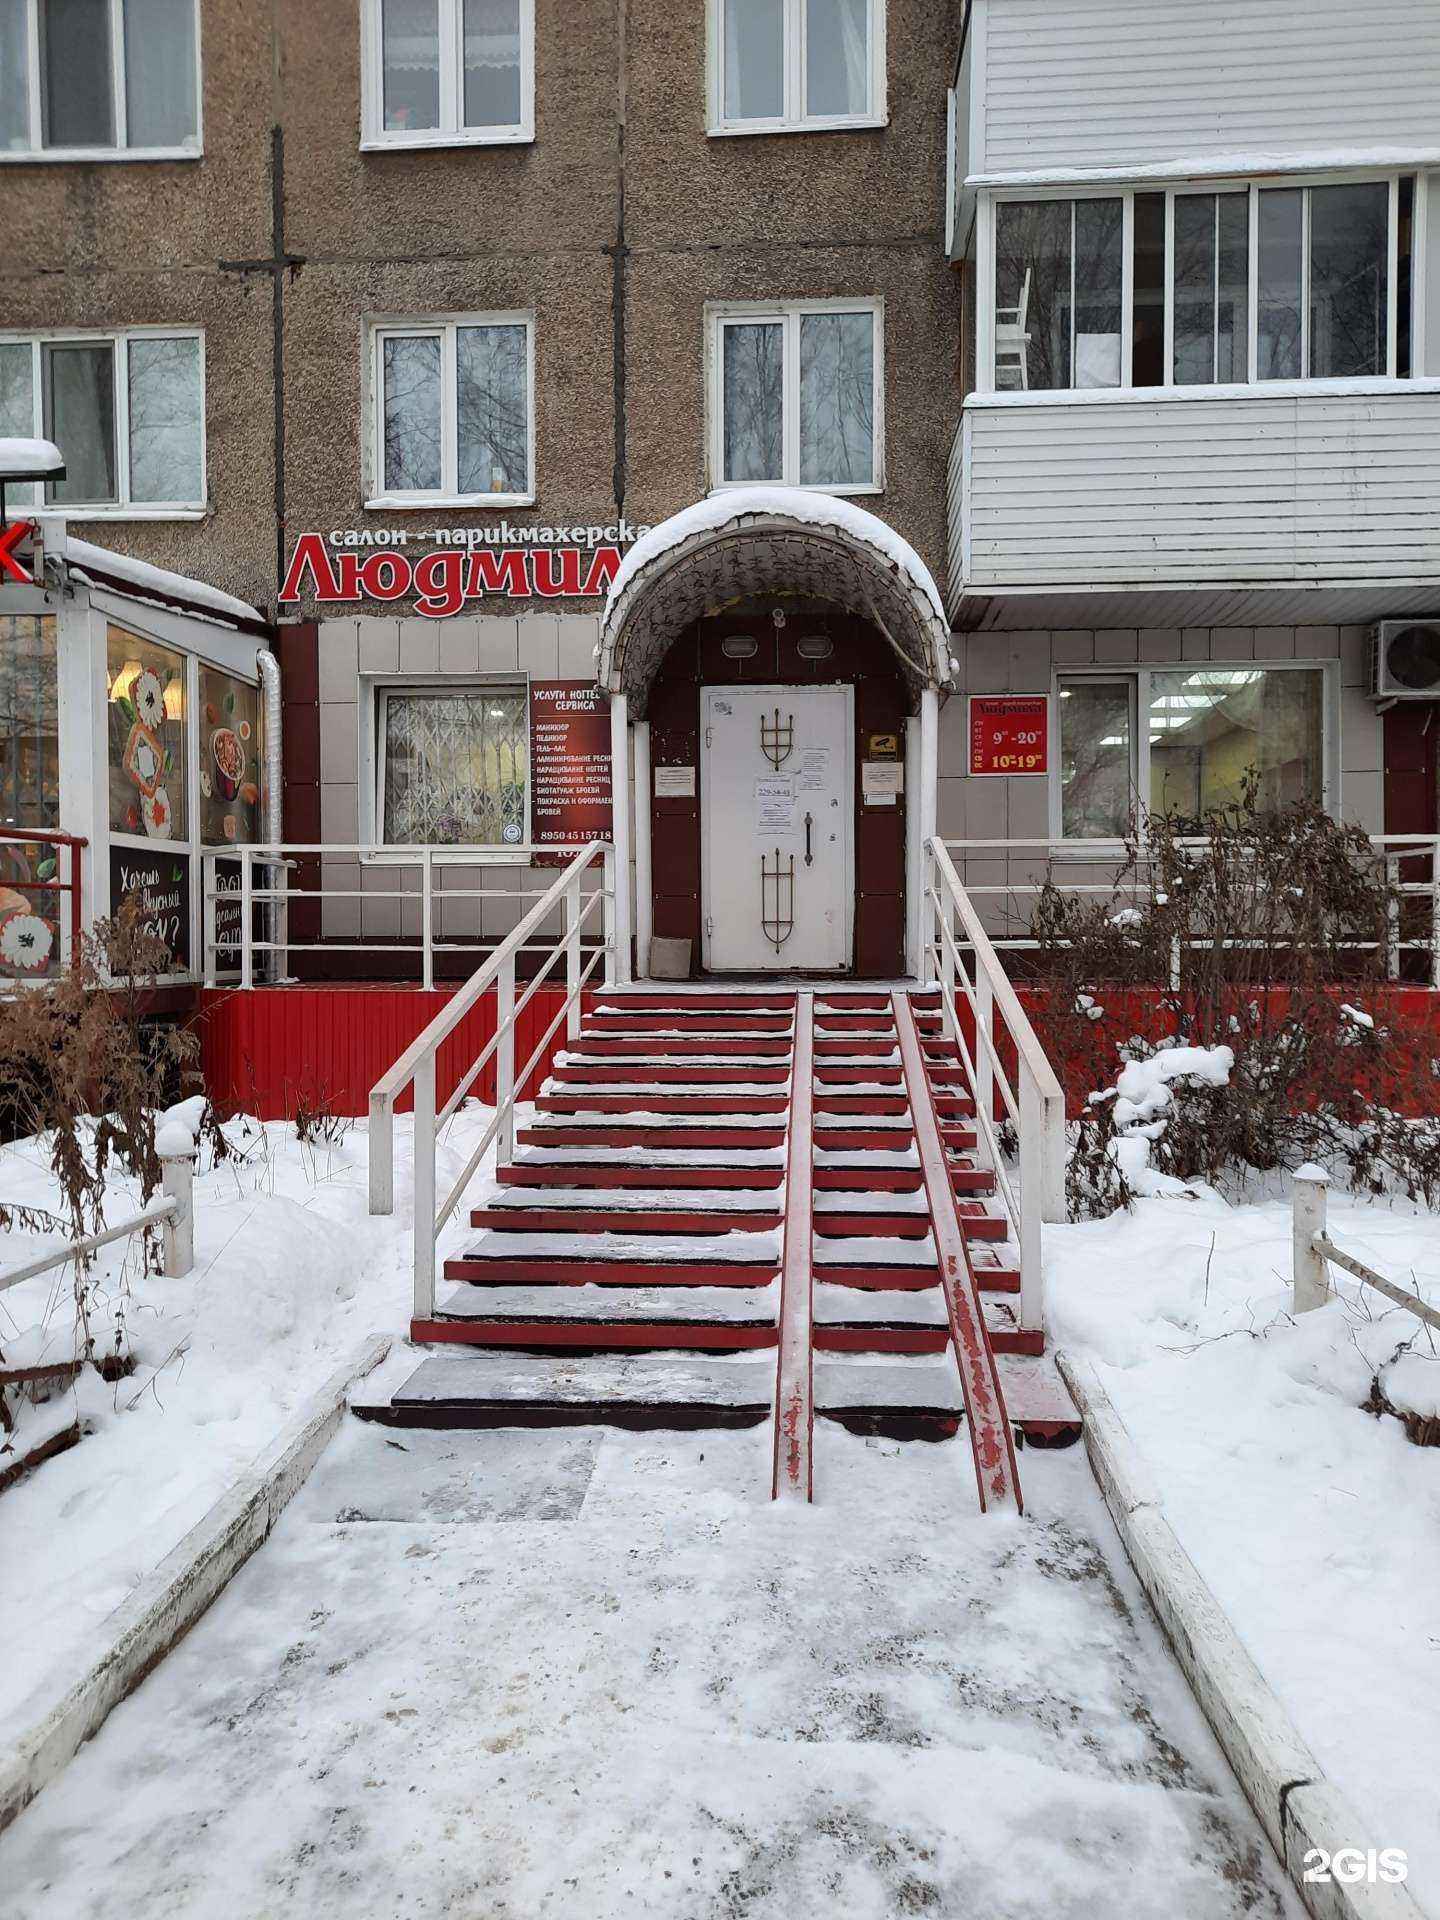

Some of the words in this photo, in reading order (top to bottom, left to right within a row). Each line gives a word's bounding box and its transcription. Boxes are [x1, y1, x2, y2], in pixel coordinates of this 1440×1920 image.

[329, 527, 408, 547] салон
[435, 518, 651, 550] парикмахерска
[278, 532, 625, 619] Людмил
[534, 690, 566, 700] УСЛУГИ
[570, 689, 601, 700] НОГТЕ
[555, 700, 595, 711] СЕРВИСА
[577, 797, 613, 805] ОФОРМЛЕН
